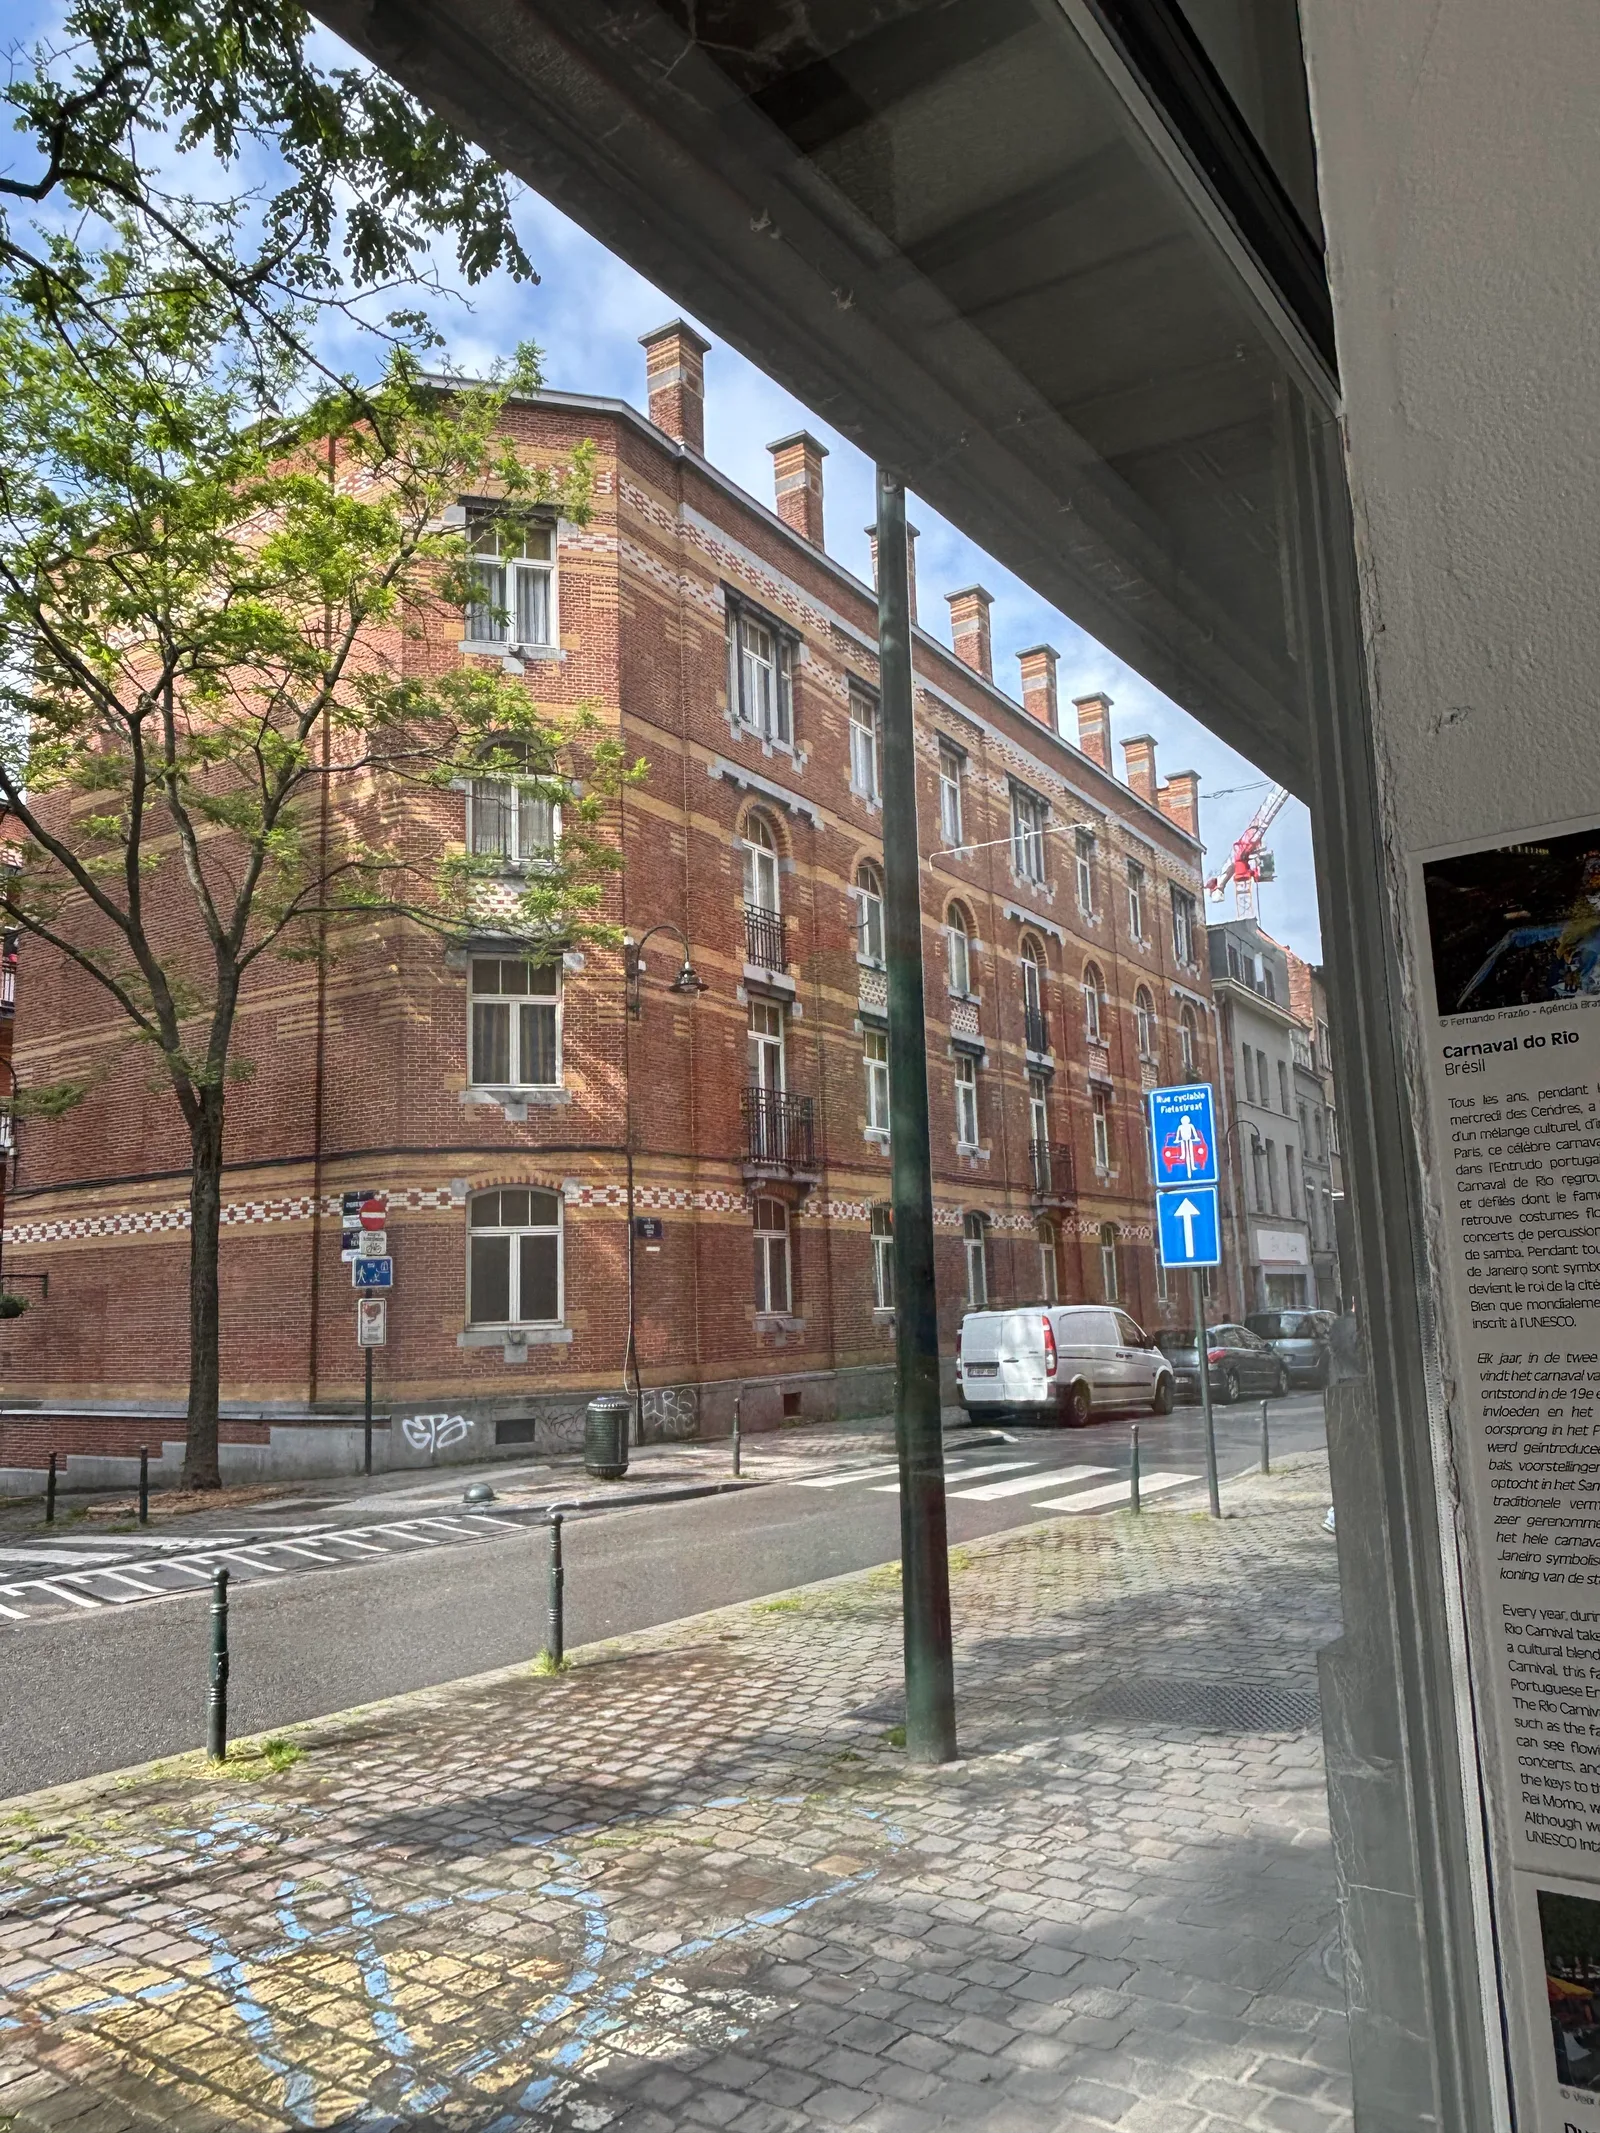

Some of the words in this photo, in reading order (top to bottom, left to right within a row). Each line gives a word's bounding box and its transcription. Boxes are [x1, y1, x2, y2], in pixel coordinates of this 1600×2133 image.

[1451, 1013, 1495, 1026] Fernando
[1539, 1001, 1578, 1015] Agência
[1443, 1037, 1518, 1058] Carnaval
[1523, 1035, 1546, 1049] do
[1551, 1030, 1580, 1046] Rio
[1445, 1059, 1486, 1076] Brésil
[1173, 1091, 1206, 1103] cyclable
[1448, 1097, 1475, 1109] Tous
[1483, 1095, 1499, 1105] les
[1538, 1084, 1589, 1102] pendant
[1450, 1110, 1502, 1126] mercredi
[1506, 1109, 1527, 1120] des
[1531, 1104, 1583, 1118] Cendres,
[1452, 1131, 1477, 1142] d'un
[1480, 1126, 1530, 1139] mélange
[1488, 1146, 1502, 1156] ce
[1507, 1141, 1551, 1154] célèbre
[1456, 1164, 1483, 1175] dans
[1457, 1178, 1506, 1192] Carnaval
[1513, 1177, 1529, 1188] de
[1536, 1175, 1554, 1187] Rio
[1460, 1198, 1472, 1209] et
[1478, 1196, 1515, 1208] défilés
[1522, 1194, 1550, 1205] dont
[1556, 1192, 1566, 1203] le
[1461, 1214, 1512, 1226] retrouve
[1519, 1210, 1579, 1223] costumes
[1463, 1231, 1514, 1243] concerts
[1518, 1229, 1534, 1240] de
[1465, 1249, 1480, 1260] de
[1483, 1247, 1524, 1259] samba.
[1527, 1244, 1578, 1257] Pendant
[1467, 1266, 1481, 1277] de
[1486, 1265, 1528, 1277] Janeiro
[1532, 1263, 1559, 1275] sont
[1468, 1282, 1513, 1294] devient
[1515, 1282, 1526, 1293] le
[1528, 1281, 1544, 1292] roi
[1547, 1281, 1563, 1292] de
[1565, 1280, 1575, 1291] la
[1470, 1300, 1496, 1312] Bien
[1500, 1301, 1523, 1313] que
[1472, 1317, 1507, 1329] inscrit
[1511, 1318, 1517, 1328] à
[1477, 1353, 1493, 1364] Elk
[1497, 1353, 1522, 1365] jaar,
[1528, 1352, 1539, 1364] in
[1544, 1352, 1561, 1364] de
[1566, 1353, 1598, 1364] twee
[1480, 1370, 1511, 1381] vindt
[1511, 1370, 1533, 1381] het
[1534, 1369, 1585, 1381] carnaval
[1481, 1388, 1537, 1399] ontstond
[1538, 1388, 1549, 1399] in
[1551, 1388, 1567, 1399] de
[1570, 1388, 1594, 1399] 19e
[1482, 1405, 1540, 1417] invloeden
[1547, 1408, 1563, 1417] en
[1571, 1406, 1594, 1417] het
[1485, 1425, 1548, 1437] oorsprong
[1551, 1424, 1563, 1435] in
[1566, 1424, 1589, 1436] het
[1487, 1442, 1518, 1453] werd
[1491, 1478, 1541, 1490] optocht
[1541, 1478, 1552, 1490] in
[1554, 1479, 1576, 1491] het
[1493, 1496, 1561, 1509] traditionele
[1494, 1515, 1521, 1525] zeer
[1496, 1531, 1518, 1543] het
[1522, 1532, 1549, 1545] hele
[1497, 1549, 1542, 1563] Janeiro
[1500, 1567, 1540, 1583] koning
[1543, 1572, 1565, 1583] van
[1568, 1572, 1585, 1584] de
[1502, 1604, 1537, 1620] Every
[1504, 1622, 1523, 1635] Rio
[1525, 1624, 1574, 1639] Carnival
[1506, 1643, 1514, 1653] a
[1517, 1643, 1563, 1657] cultural
[1563, 1665, 1586, 1679] this
[1510, 1678, 1583, 1697] Portuguese
[1512, 1696, 1537, 1711] The
[1538, 1699, 1557, 1713] Rio
[1514, 1717, 1544, 1730] such
[1547, 1722, 1560, 1732] as
[1563, 1721, 1586, 1735] the
[1516, 1736, 1538, 1748] can
[1543, 1740, 1565, 1752] see
[1520, 1773, 1542, 1787] the
[1543, 1775, 1572, 1792] keys
[1574, 1780, 1588, 1793] to
[1522, 1791, 1540, 1805] Rei
[1542, 1794, 1586, 1813] Momo,
[1524, 1811, 1583, 1831] Although
[1525, 1829, 1577, 1849] UNESCO
